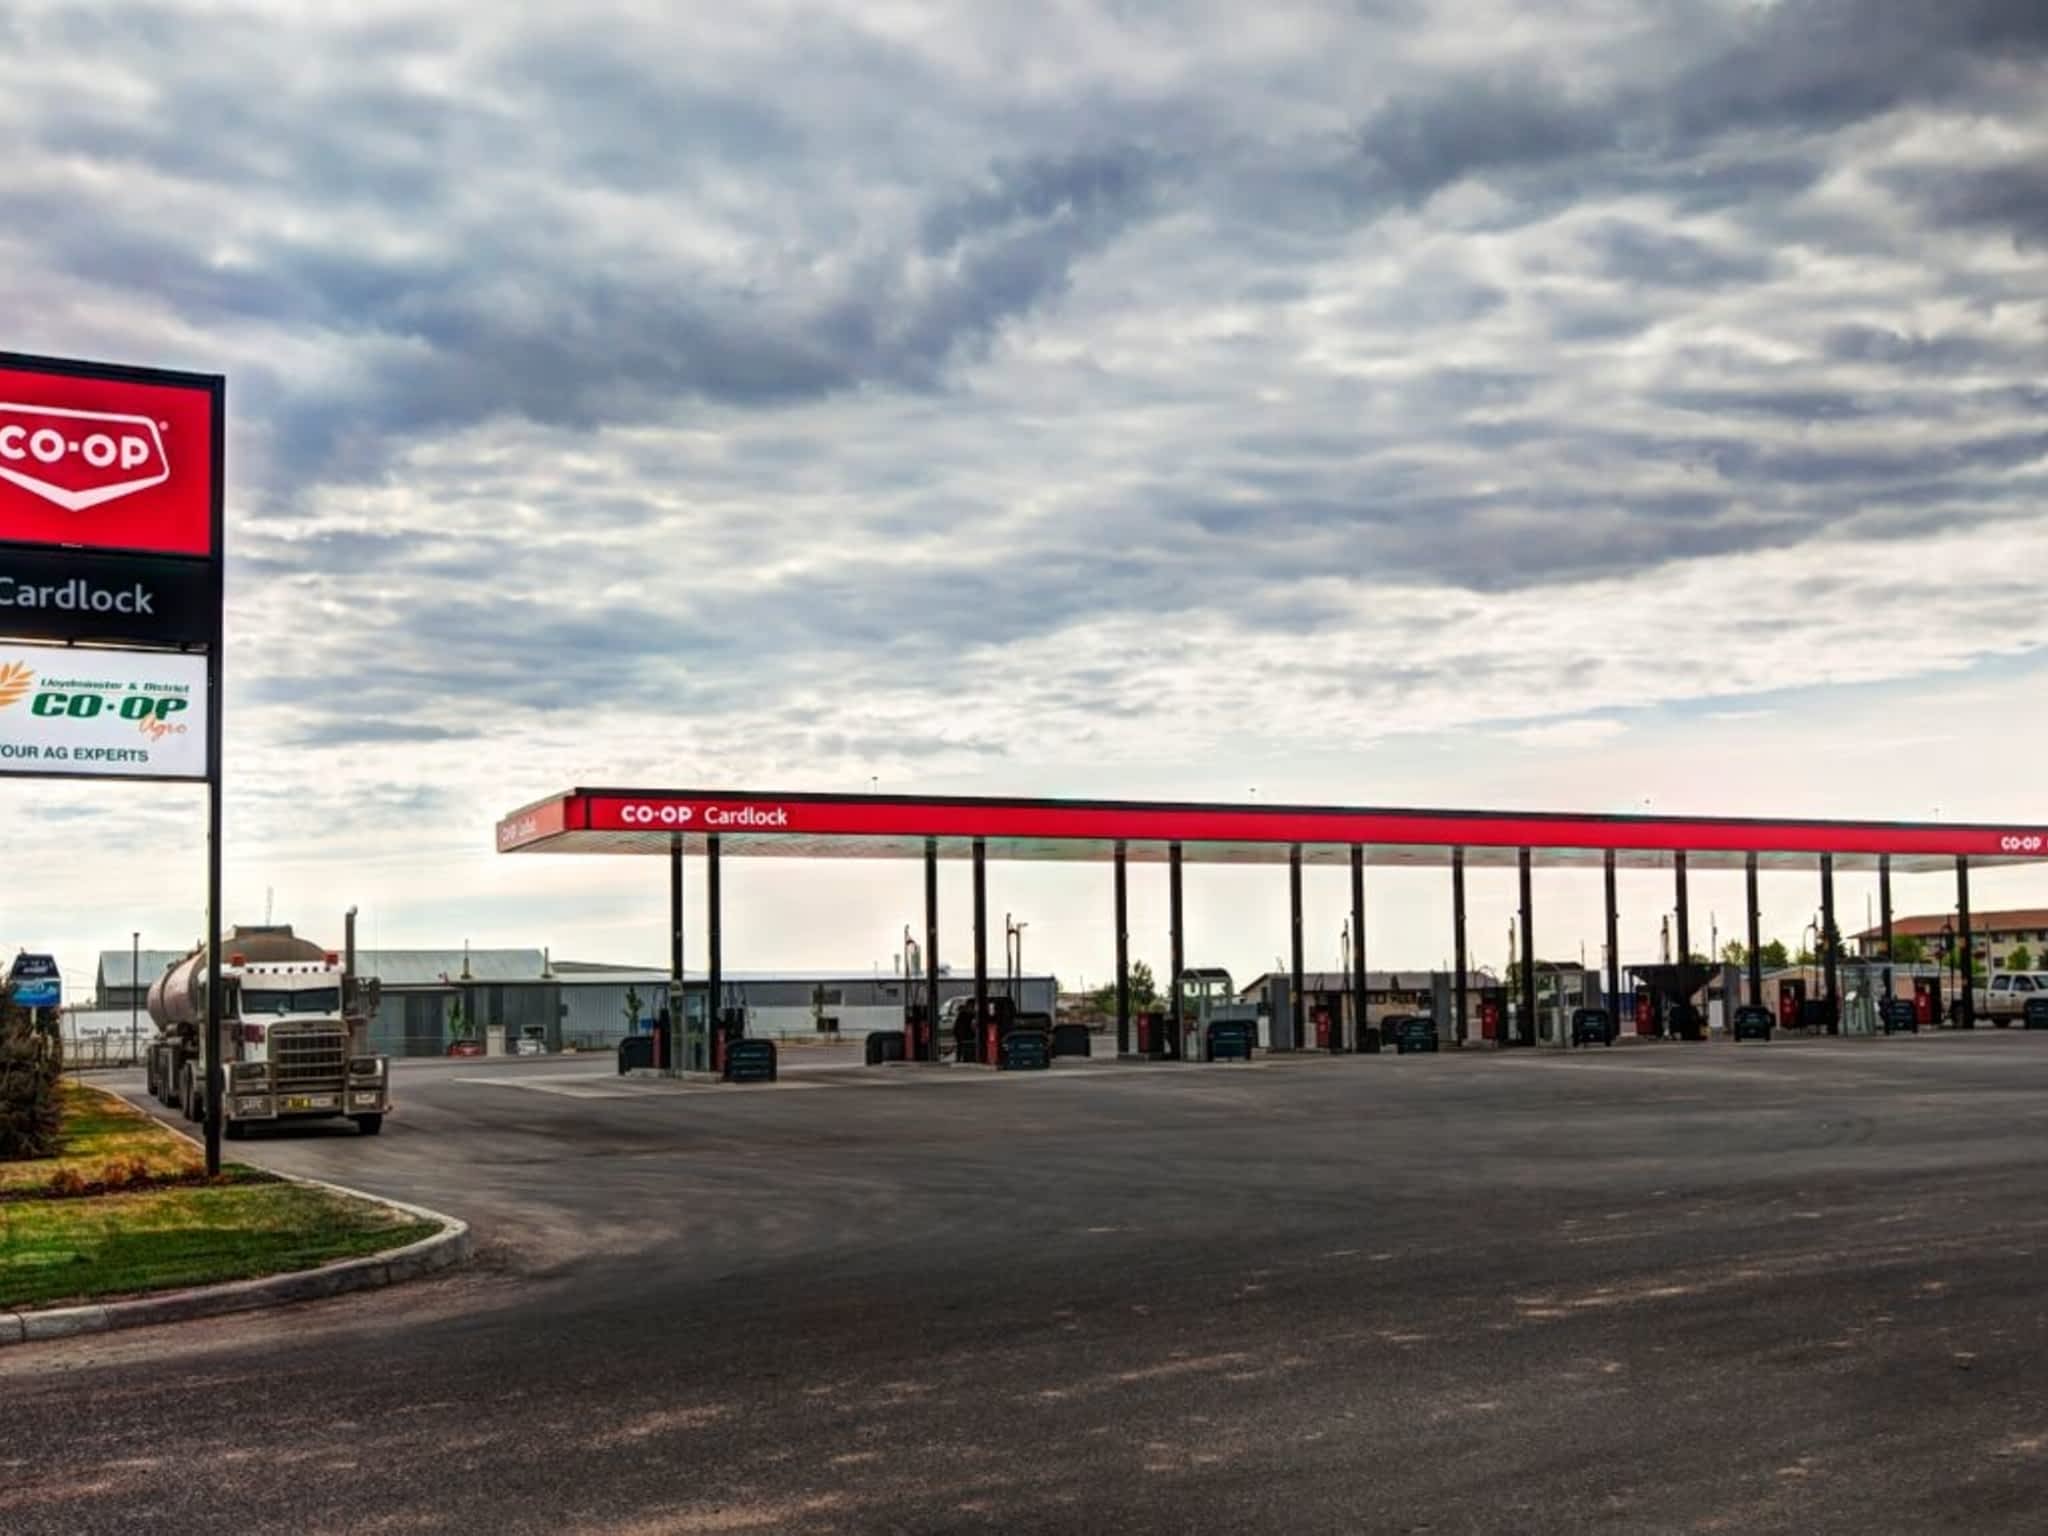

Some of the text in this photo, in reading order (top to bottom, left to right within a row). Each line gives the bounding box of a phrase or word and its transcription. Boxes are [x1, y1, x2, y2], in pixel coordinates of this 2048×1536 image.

[0, 576, 154, 614] Cardlock
[128, 682, 138, 691] &
[143, 682, 190, 693] District
[43, 746, 69, 760] AG
[73, 747, 149, 763] EXPERTS
[704, 806, 788, 825] Cardlock
